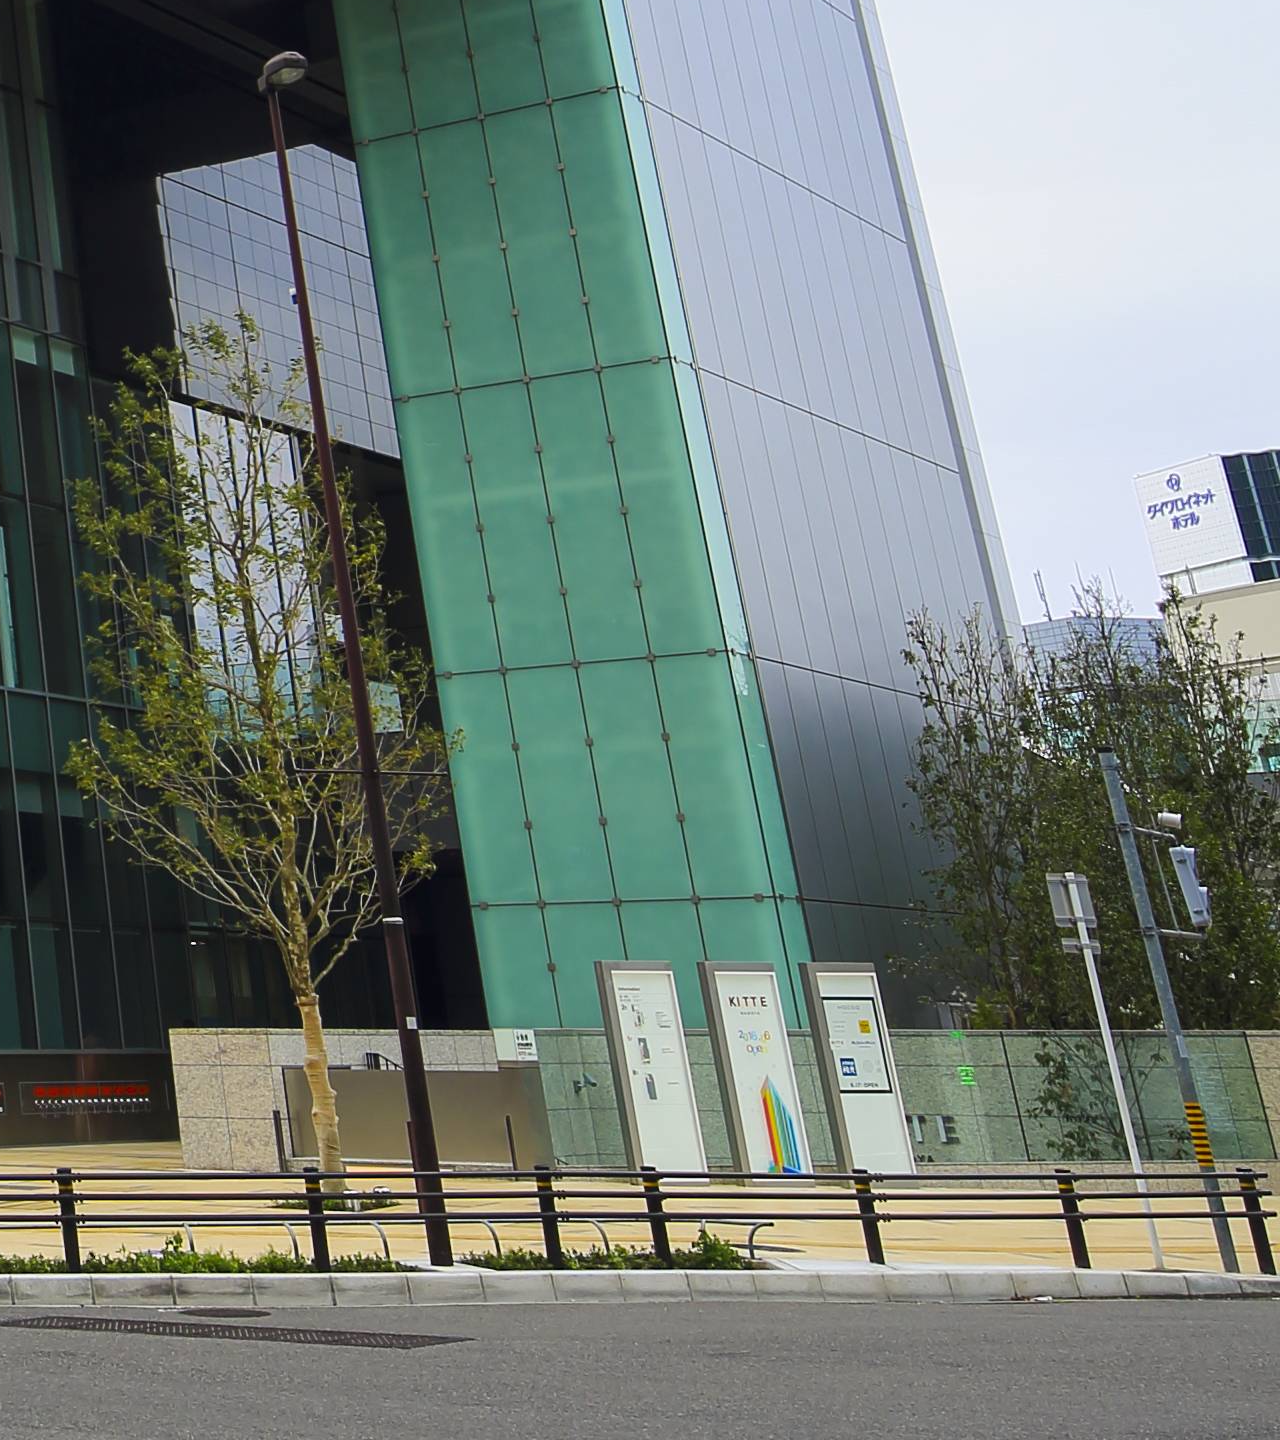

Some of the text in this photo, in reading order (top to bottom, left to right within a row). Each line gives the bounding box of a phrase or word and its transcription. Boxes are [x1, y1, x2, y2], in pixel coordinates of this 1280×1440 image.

[1147, 488, 1216, 520] ダイワロイネット
[1170, 511, 1200, 530] ホテル
[728, 996, 768, 1008] KITTE
